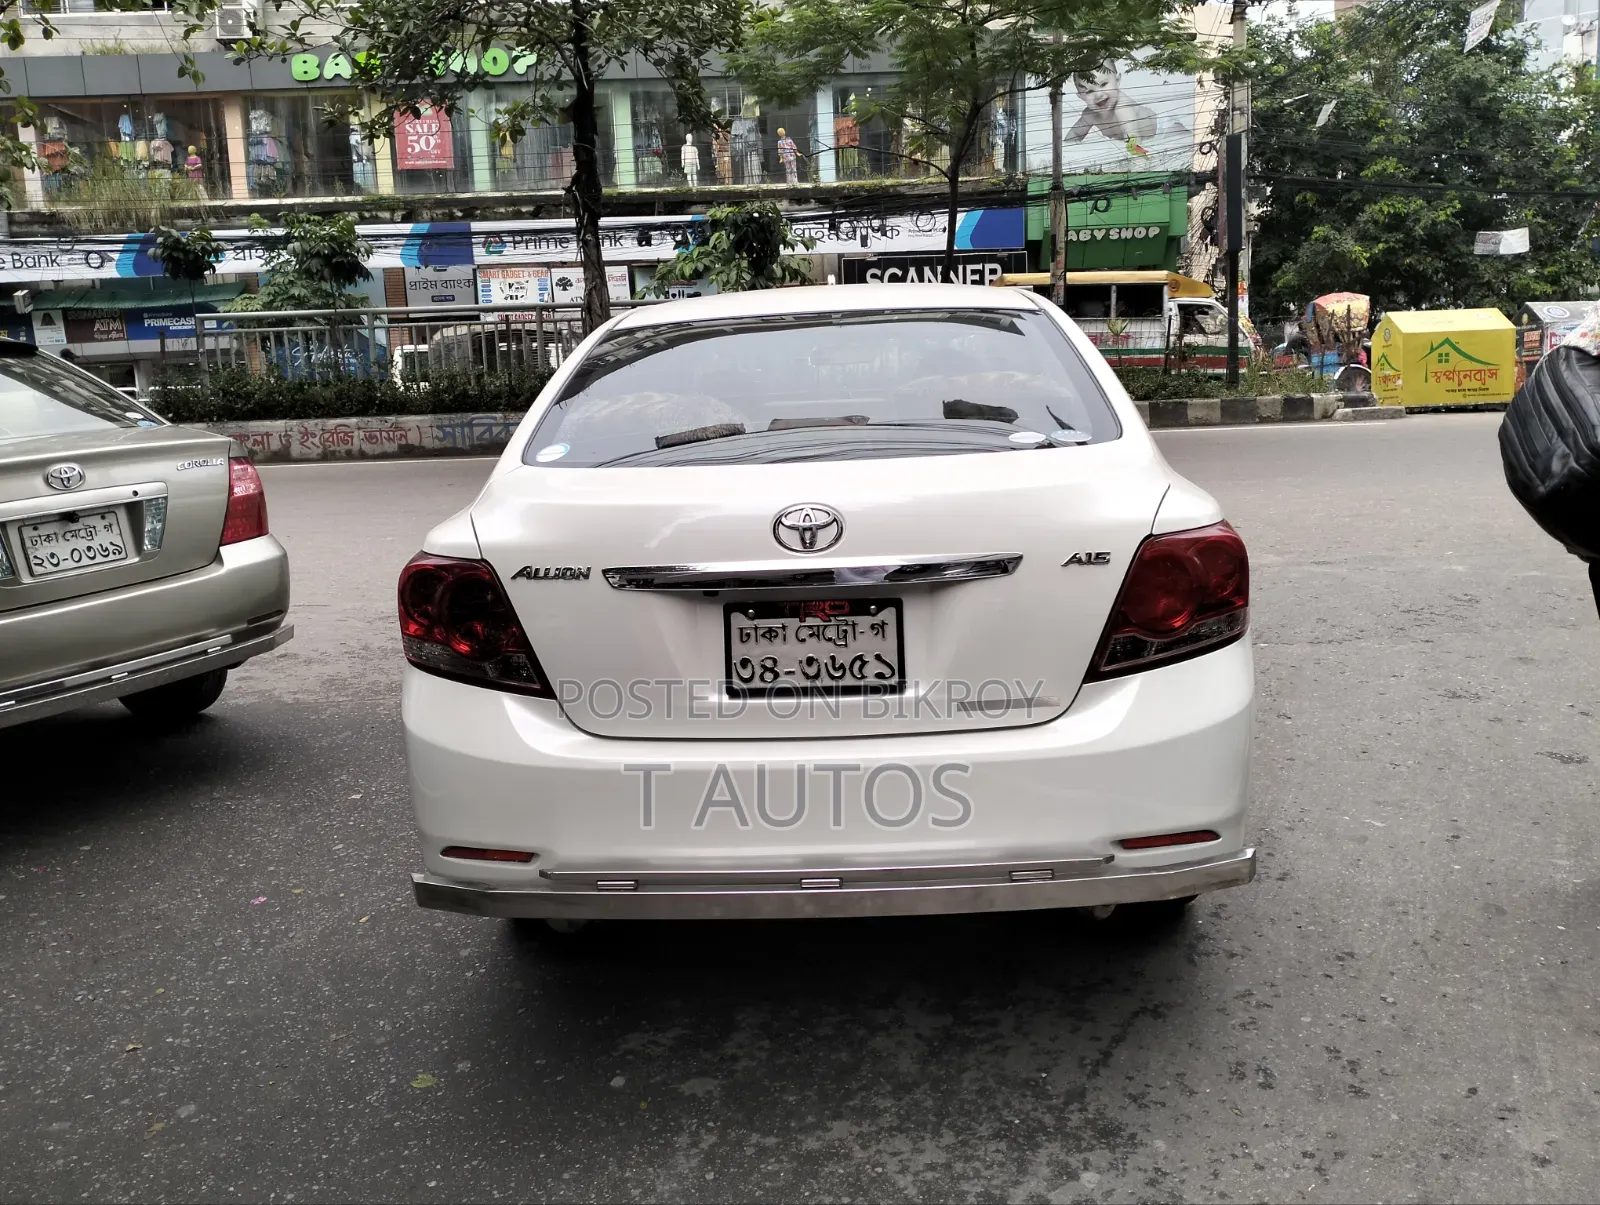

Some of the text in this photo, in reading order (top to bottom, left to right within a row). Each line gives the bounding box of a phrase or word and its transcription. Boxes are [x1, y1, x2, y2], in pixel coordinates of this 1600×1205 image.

[405, 123, 440, 134] SALE
[512, 233, 571, 250] Prime
[1067, 226, 1160, 241] ABY SHOP
[11, 251, 61, 269] Bank
[480, 269, 500, 278] SMART
[502, 269, 525, 278] GADGET
[533, 269, 549, 277] GEAR
[409, 277, 475, 291] প্রাইম ব্যাংক
[93, 319, 122, 331] ATM
[299, 425, 355, 450] ইংরেজি
[176, 457, 225, 471] COROLLA
[29, 532, 58, 547] ঢাকা
[32, 541, 123, 569] ২৩-০৩৬৯
[1060, 550, 1111, 567] A15
[510, 565, 592, 581] ALLION
[737, 621, 788, 644] ঢাকা
[733, 652, 896, 684] ৩৪-৩৬৫১
